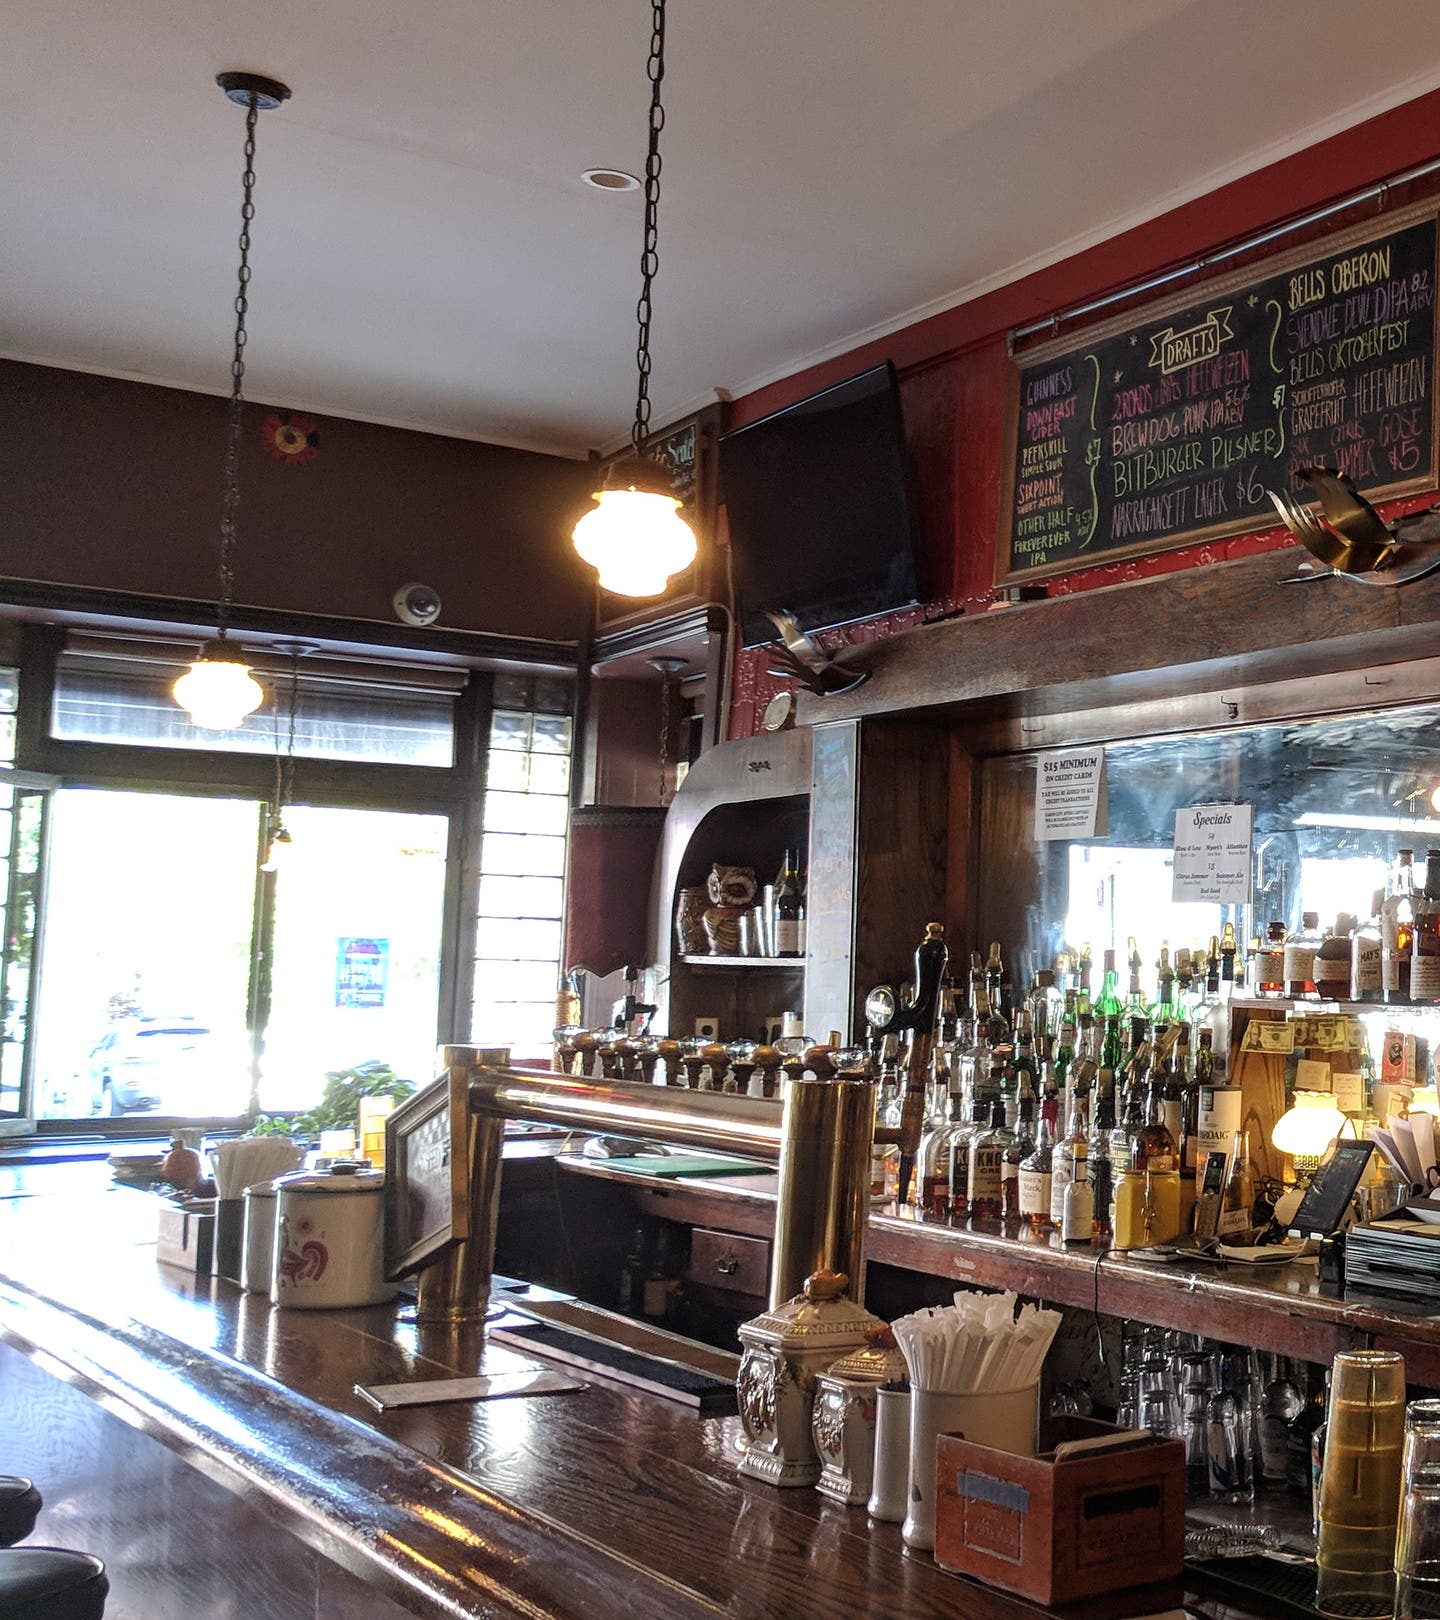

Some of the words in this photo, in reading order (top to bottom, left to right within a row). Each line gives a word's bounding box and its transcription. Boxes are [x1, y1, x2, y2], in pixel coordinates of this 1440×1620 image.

[1288, 269, 1326, 311] BELLS
[1332, 244, 1390, 295] OBERON
[1167, 327, 1215, 366] DRAFTS
[1290, 347, 1325, 386] BELLS
[1328, 319, 1411, 372] OKTOBERFEST
[1026, 366, 1072, 405] GUINNESS
[1112, 412, 1180, 457] BREWDOG
[1184, 401, 1210, 435] PUNK
[1224, 405, 1245, 426] ABV
[1290, 396, 1348, 436] GRAPEFRUIT
[1379, 407, 1423, 448] GOSE
[1113, 441, 1204, 498] BITBURGER
[1211, 428, 1276, 469] PILSNER
[1387, 438, 1420, 472] $5
[1018, 473, 1063, 505] SIXPOINT
[1195, 477, 1228, 519] LAGER
[1236, 465, 1264, 509] $6
[1017, 515, 1046, 537] OTHER
[1047, 506, 1075, 530] HALF
[1030, 551, 1047, 566] IPA
[1043, 762, 1058, 772] $15
[1059, 757, 1097, 770] MINIMUM
[1055, 773, 1073, 781] CREDIT
[1193, 811, 1233, 829] Specials
